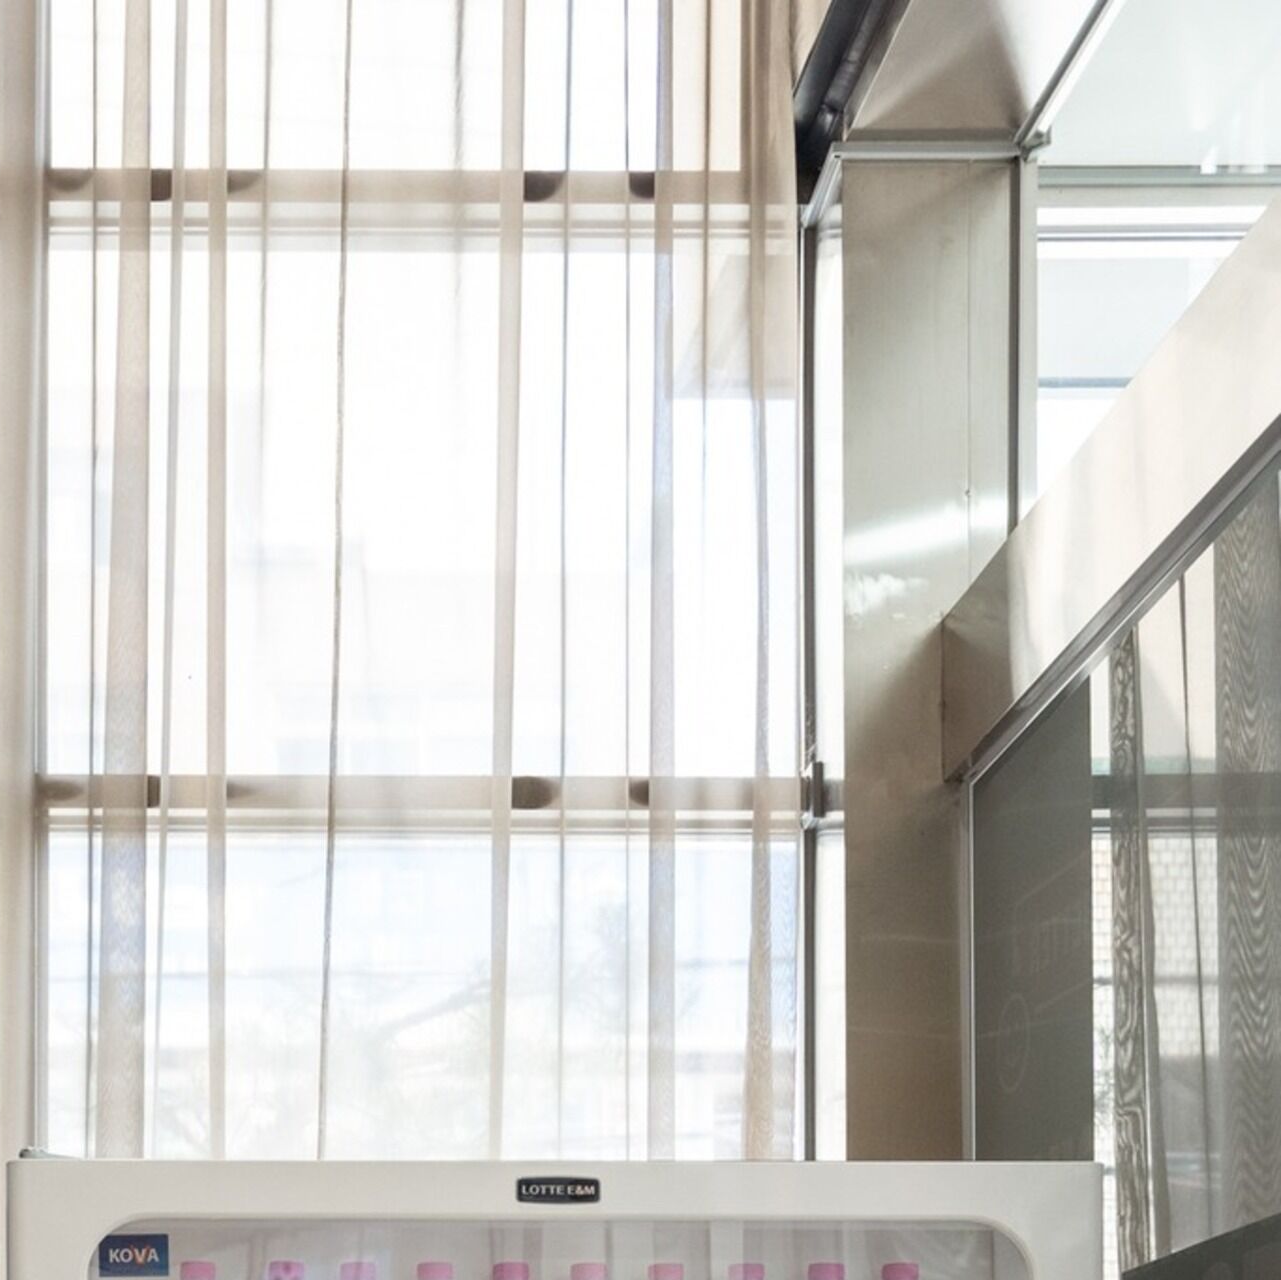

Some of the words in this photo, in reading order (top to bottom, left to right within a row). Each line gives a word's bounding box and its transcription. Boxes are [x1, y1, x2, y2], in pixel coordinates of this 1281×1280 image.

[521, 1184, 565, 1196] LOTTE
[567, 1184, 596, 1196] E&M
[108, 1245, 160, 1267] KOVA
